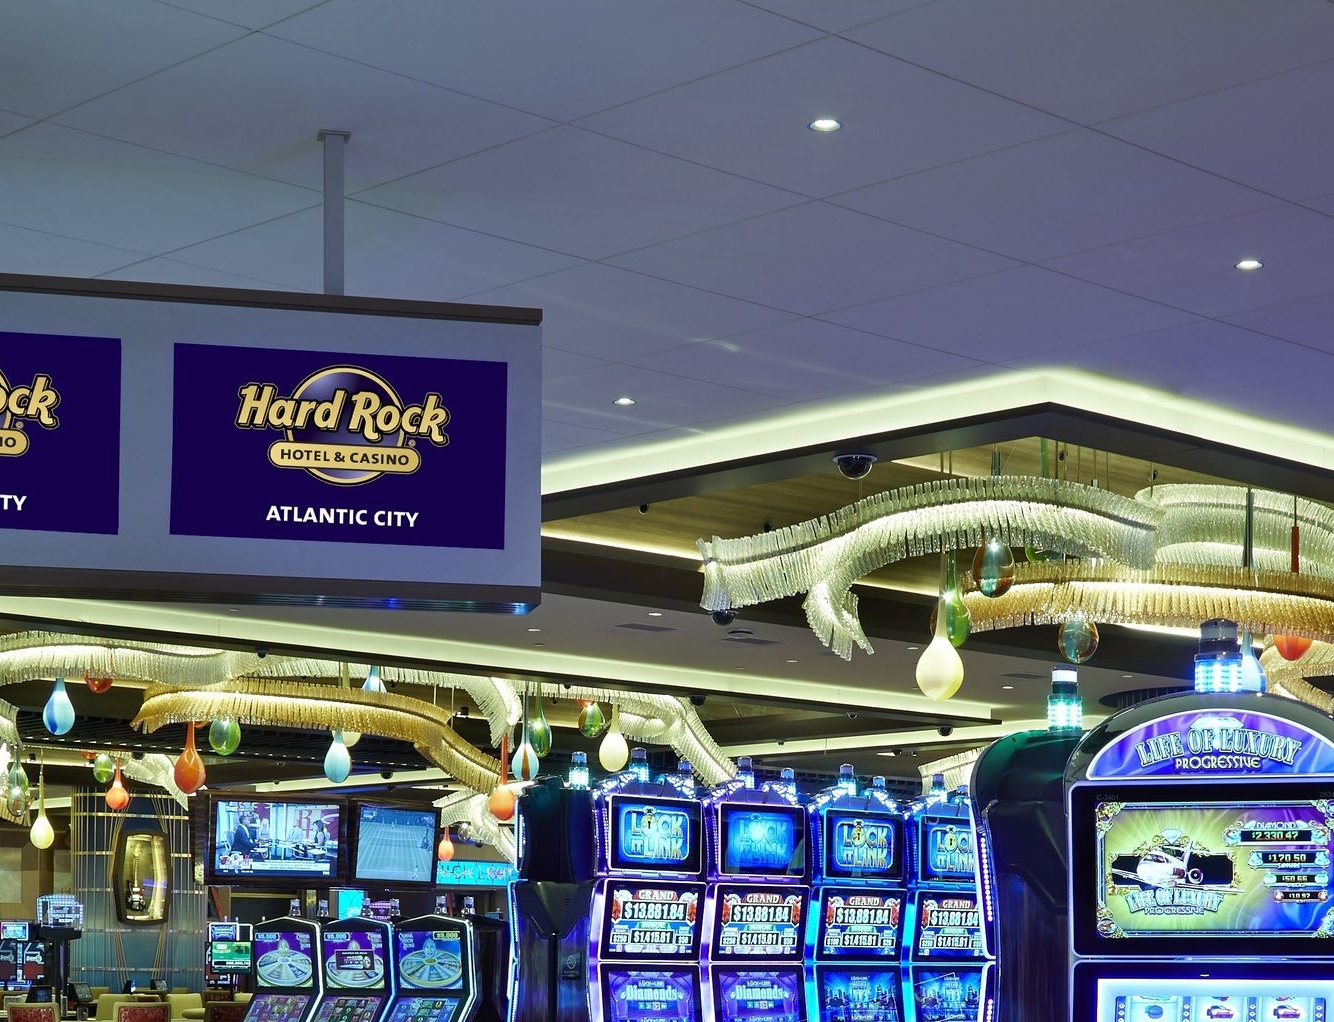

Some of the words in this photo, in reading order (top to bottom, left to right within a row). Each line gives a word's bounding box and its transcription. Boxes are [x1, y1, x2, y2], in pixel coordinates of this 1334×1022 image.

[236, 384, 347, 430] Hard
[348, 391, 451, 446] Rock
[280, 449, 330, 462] HOTEL
[334, 452, 346, 463] &
[350, 453, 409, 466] CASINO
[266, 505, 368, 526] ATLANTIC
[374, 510, 419, 528] CITY
[1135, 732, 1184, 767] LIFE
[1188, 728, 1215, 753] OF
[1220, 729, 1301, 765] LUXURY
[1175, 756, 1261, 770] PROGRESSIVE
[1268, 854, 1307, 862] $170.50
[638, 889, 674, 900] GRAND
[747, 894, 779, 903] GRAND
[849, 897, 880, 905] GRAND
[942, 900, 971, 908] GRAND
[624, 902, 685, 920] $13,881.84
[733, 905, 789, 923] $13,881.84
[836, 908, 889, 924] $13,881.84
[1144, 907, 1204, 915] PROGRESSIVE
[626, 987, 677, 1000] Diamonds
[736, 987, 784, 1000] Diamonds
